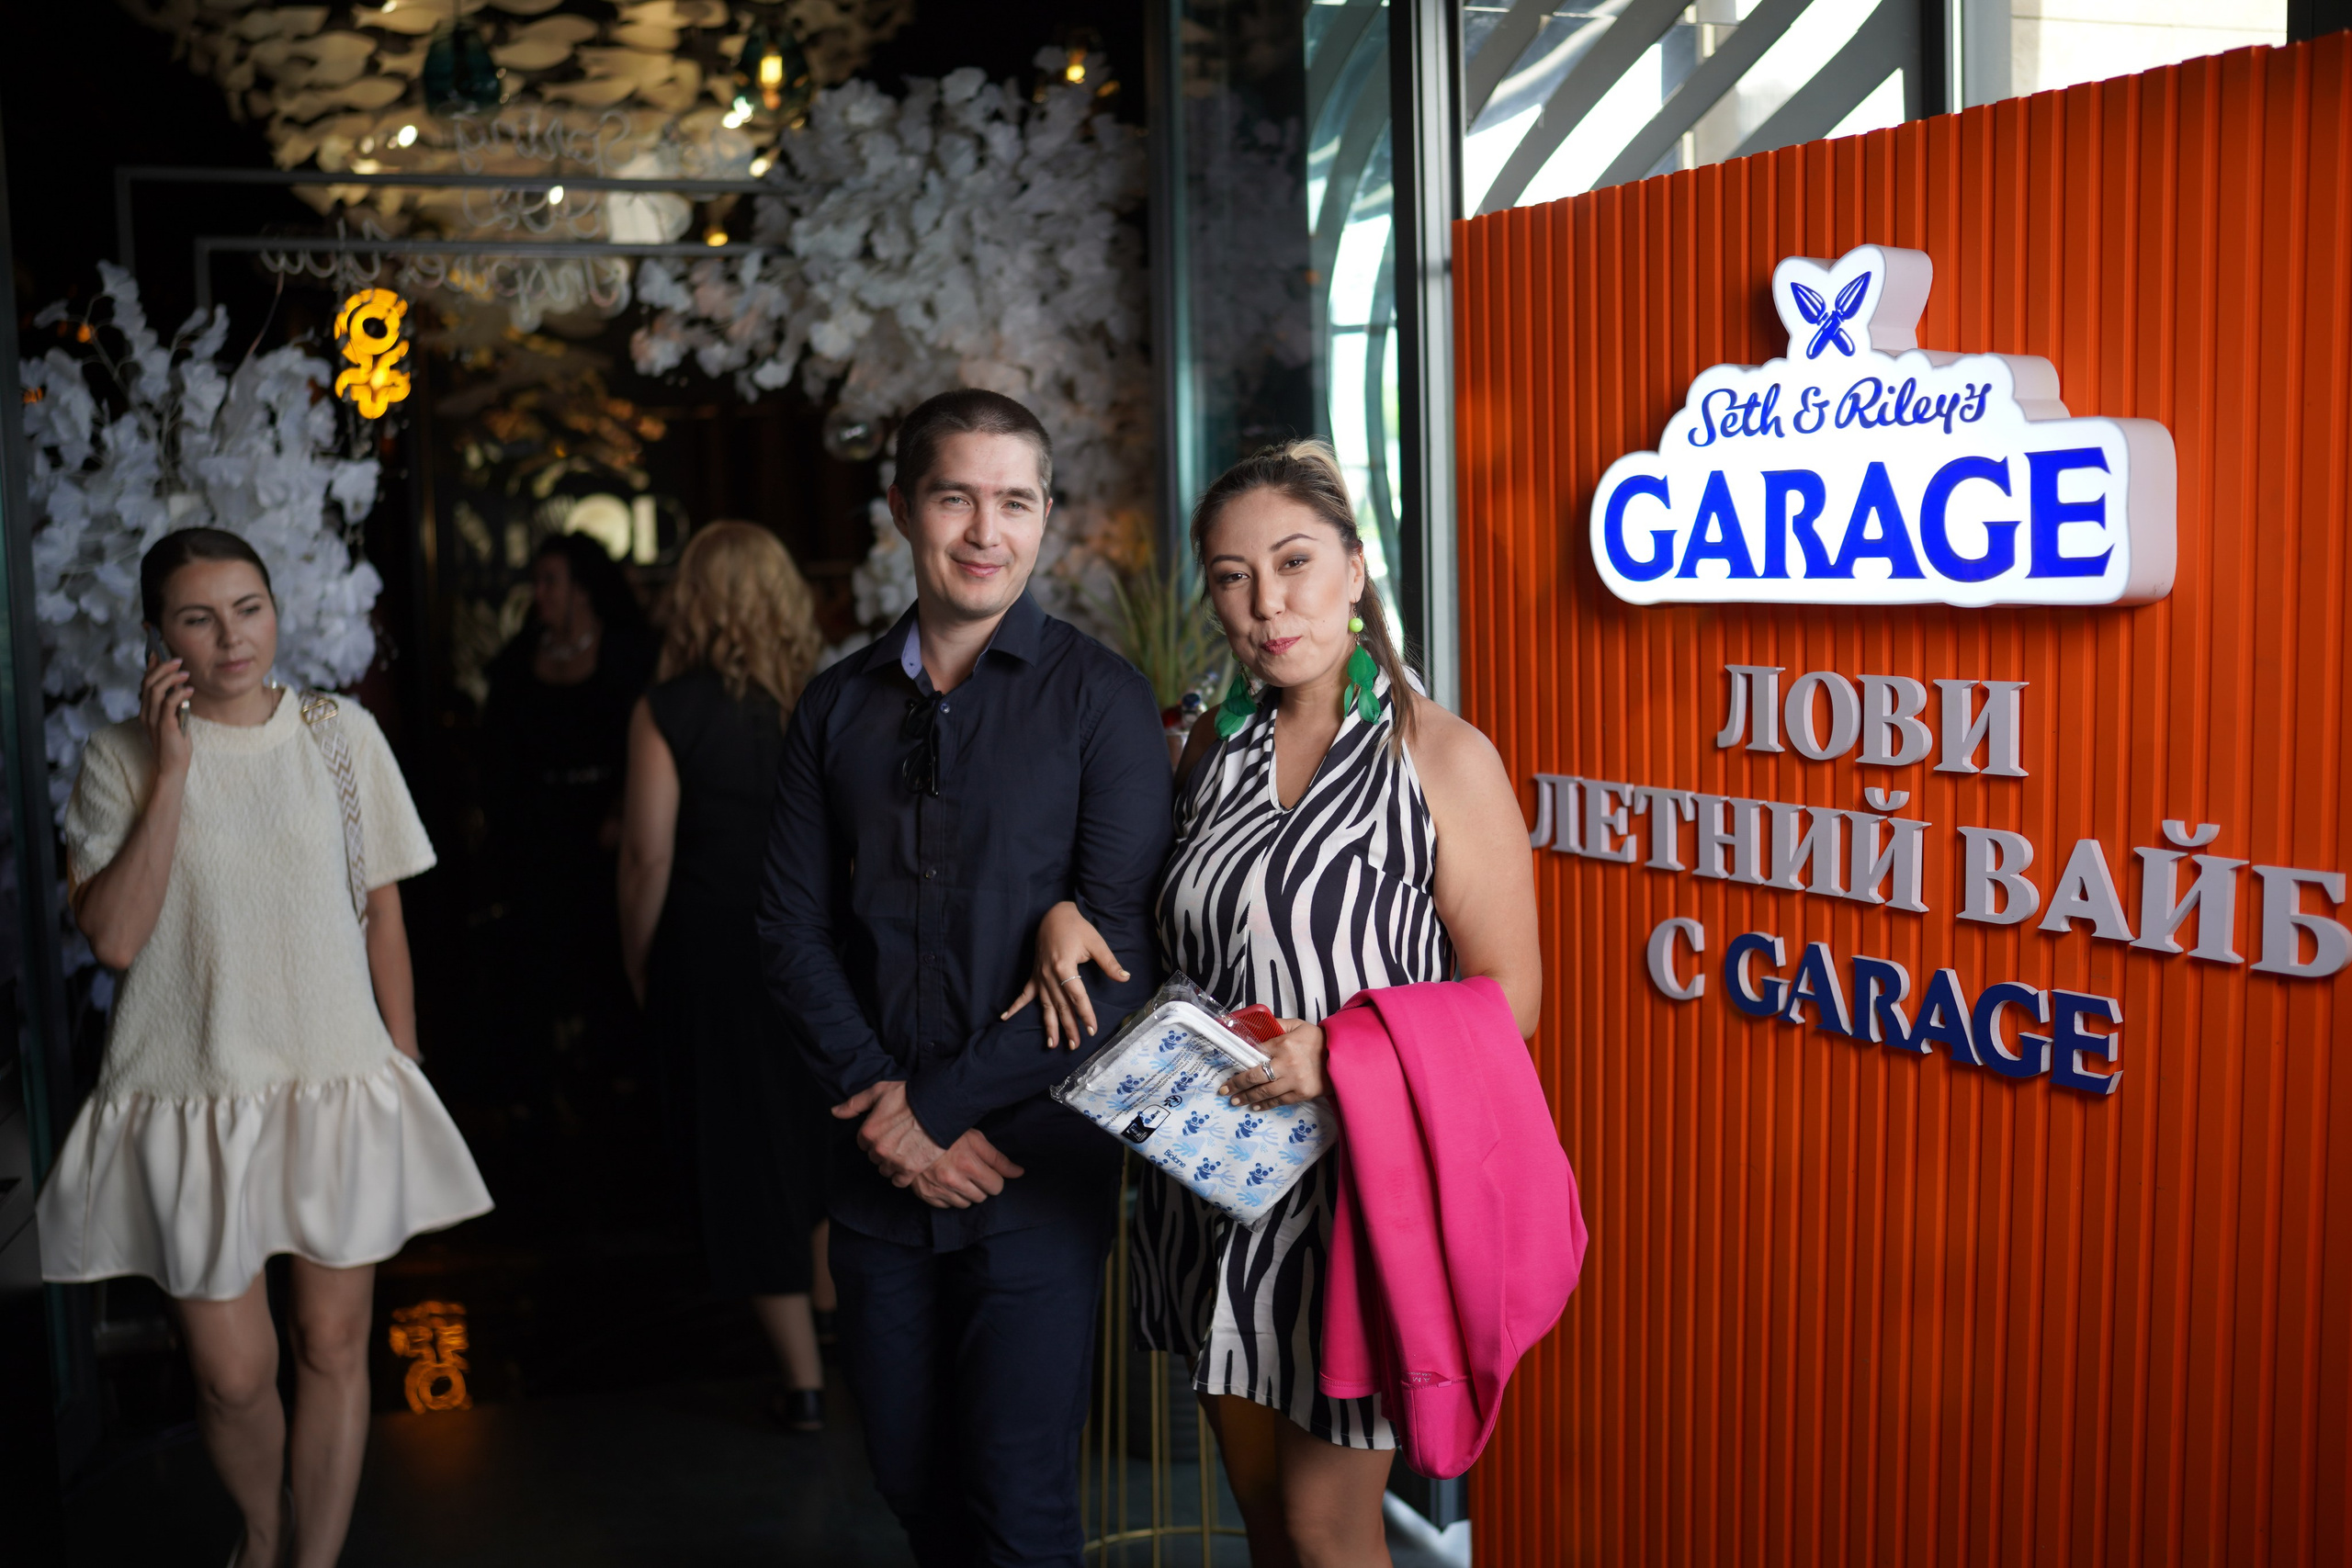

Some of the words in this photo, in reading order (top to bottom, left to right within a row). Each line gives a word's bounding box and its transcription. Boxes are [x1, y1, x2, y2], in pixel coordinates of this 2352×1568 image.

[1688, 382, 1785, 446] Seth
[1793, 386, 1830, 434] &
[1835, 377, 1993, 434] Riley's
[1604, 446, 2116, 583] GARAGE
[1717, 664, 2030, 777] ЛОВИ
[1530, 773, 1932, 914] ЛЕТНИЙ
[1955, 819, 2352, 978] ВАЙБ
[1724, 931, 2124, 1095] GARAGE
[1163, 1148, 1186, 1168] Biolane
